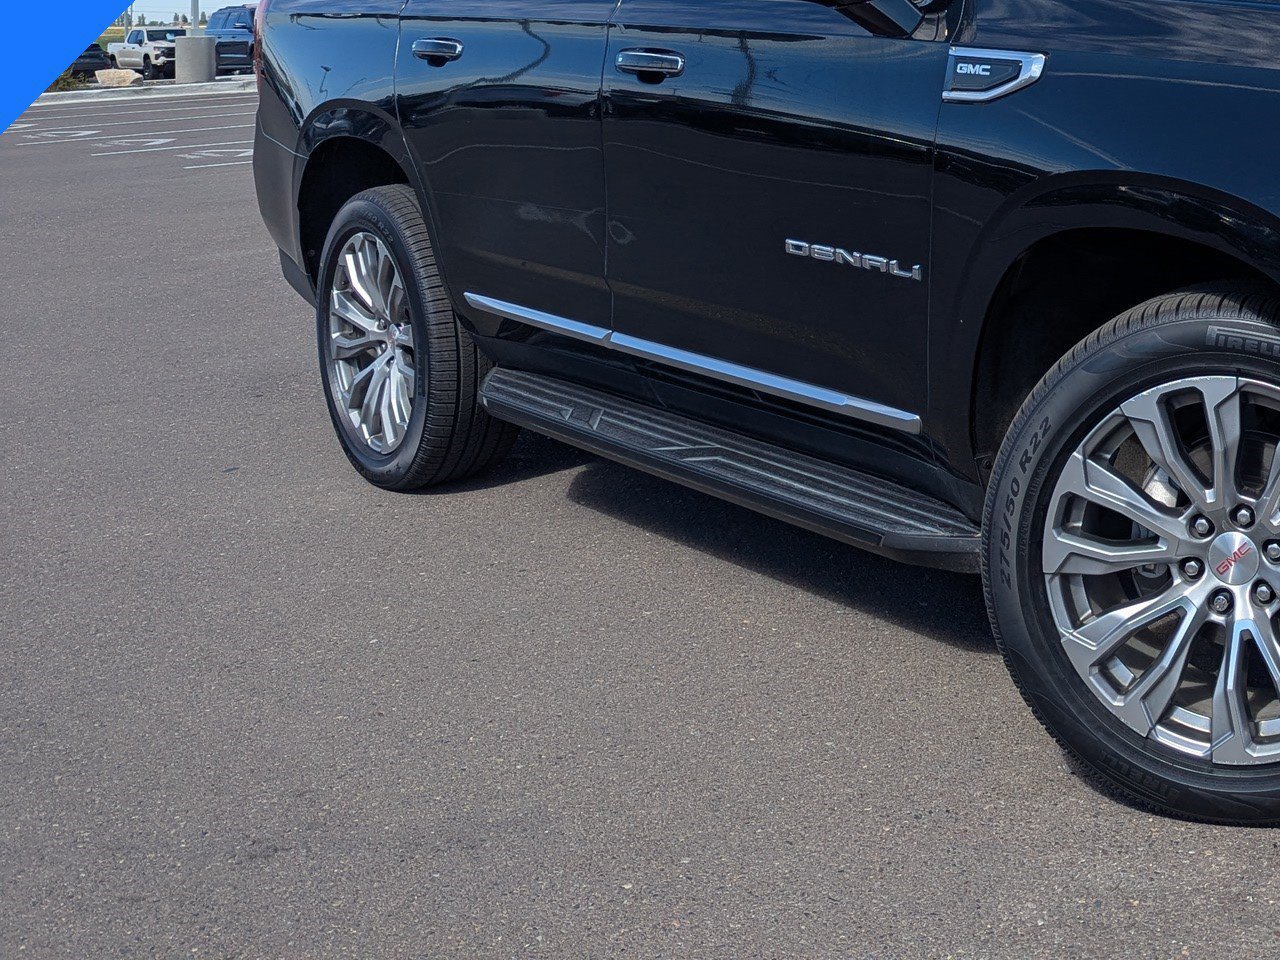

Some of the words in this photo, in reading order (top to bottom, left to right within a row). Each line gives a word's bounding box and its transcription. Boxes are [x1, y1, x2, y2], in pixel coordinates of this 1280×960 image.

[956, 63, 991, 76] GMC
[785, 238, 922, 281] DENALI
[1001, 477, 1020, 590] 275/50
[1019, 416, 1053, 475] R22
[1216, 542, 1252, 575] GMC
